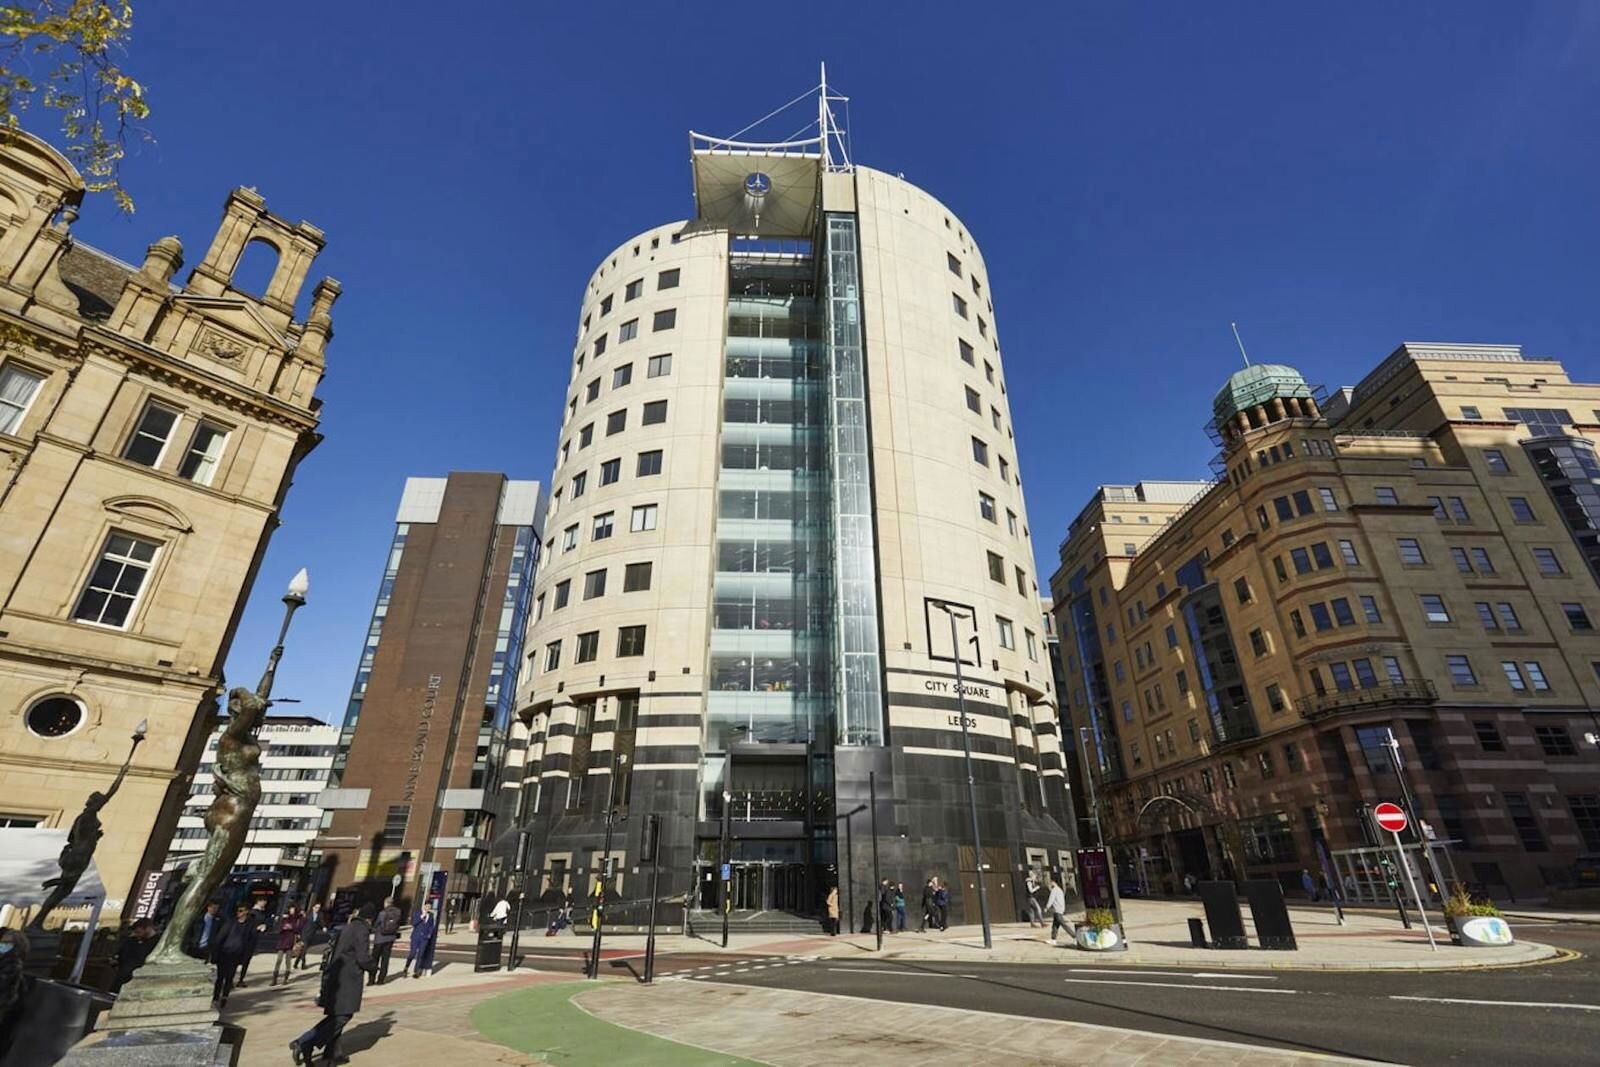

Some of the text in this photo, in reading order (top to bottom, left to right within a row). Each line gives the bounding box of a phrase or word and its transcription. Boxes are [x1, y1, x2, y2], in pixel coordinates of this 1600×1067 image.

[925, 680, 948, 692] CITY
[403, 674, 441, 801] NINE BOND COURT
